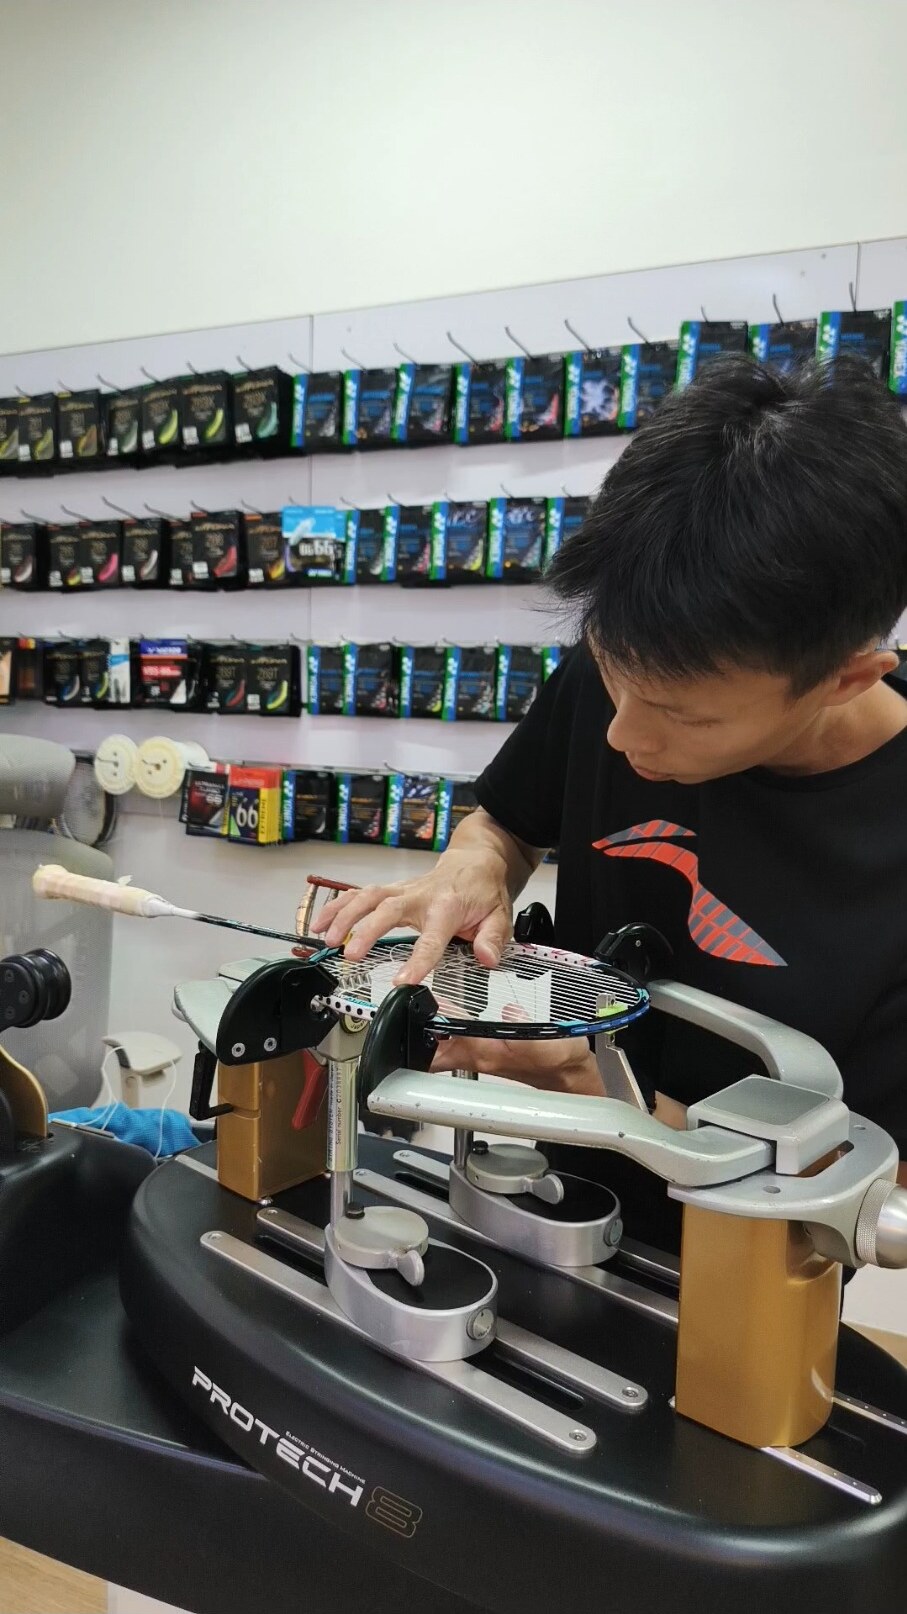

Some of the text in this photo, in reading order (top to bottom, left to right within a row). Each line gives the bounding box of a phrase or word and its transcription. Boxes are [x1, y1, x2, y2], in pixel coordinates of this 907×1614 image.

[236, 798, 259, 829] 66
[283, 799, 293, 827] YONEX
[337, 802, 348, 831] YONEX
[387, 803, 398, 833] YONEX
[436, 811, 447, 840] YONEX
[192, 1366, 423, 1538] PROTECH 8
